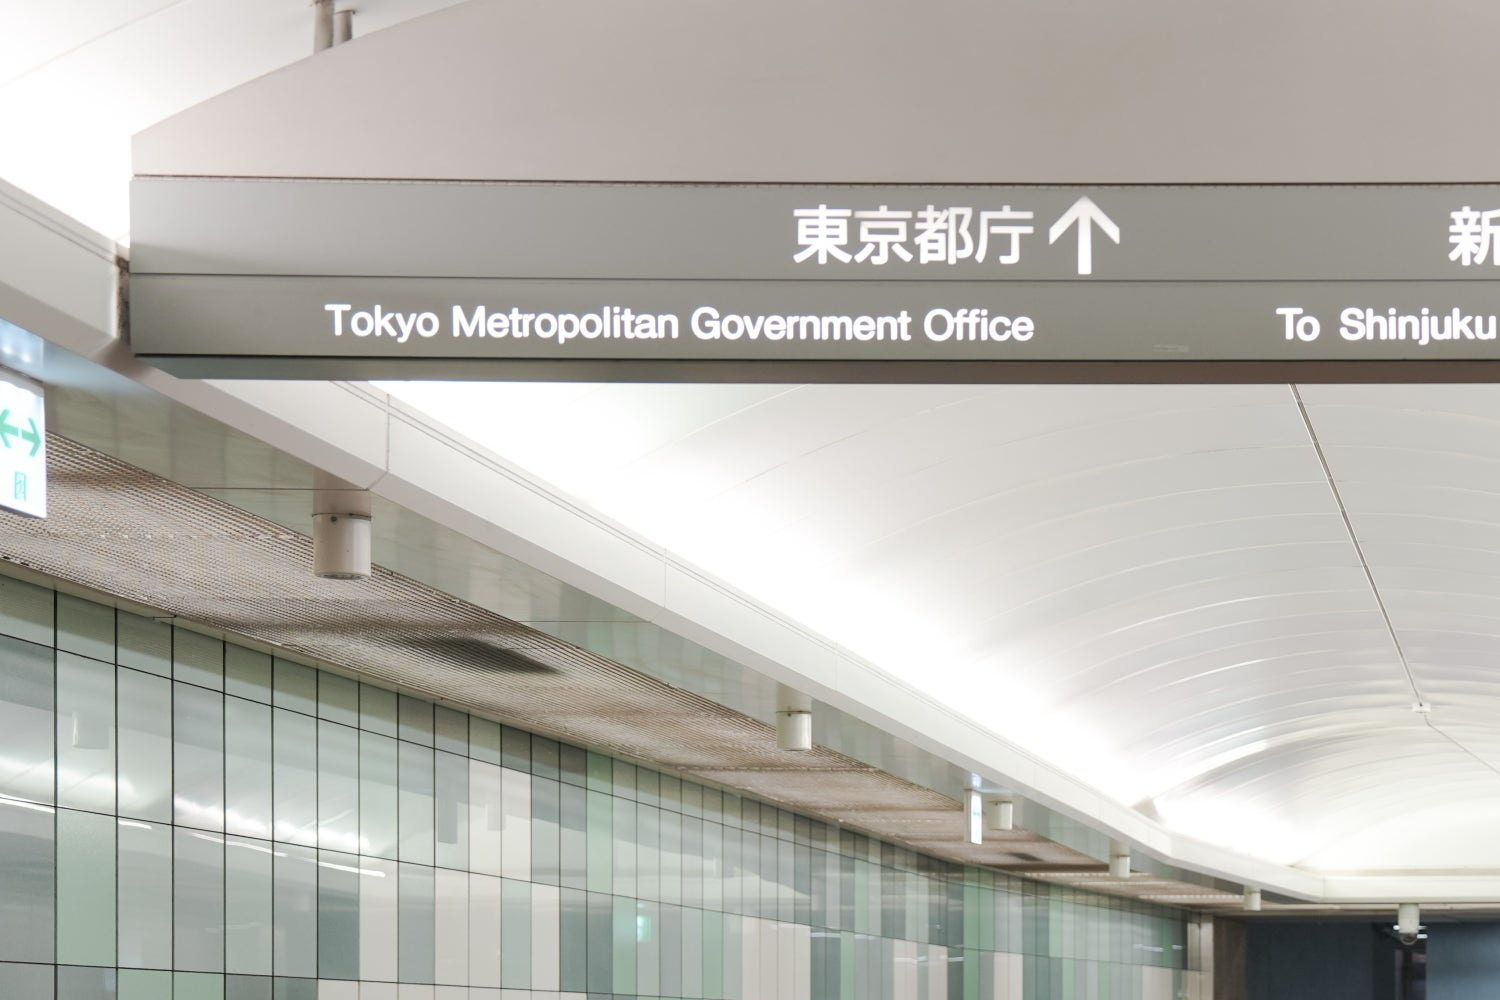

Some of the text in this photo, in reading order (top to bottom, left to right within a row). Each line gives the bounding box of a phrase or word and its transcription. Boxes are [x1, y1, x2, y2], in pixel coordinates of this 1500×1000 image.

[794, 205, 1033, 265] 東京都庁
[325, 303, 1034, 344] Tokyo Metropolitan Government Office
[1276, 308, 1321, 342] To
[1340, 308, 1497, 346] Shinjuku
